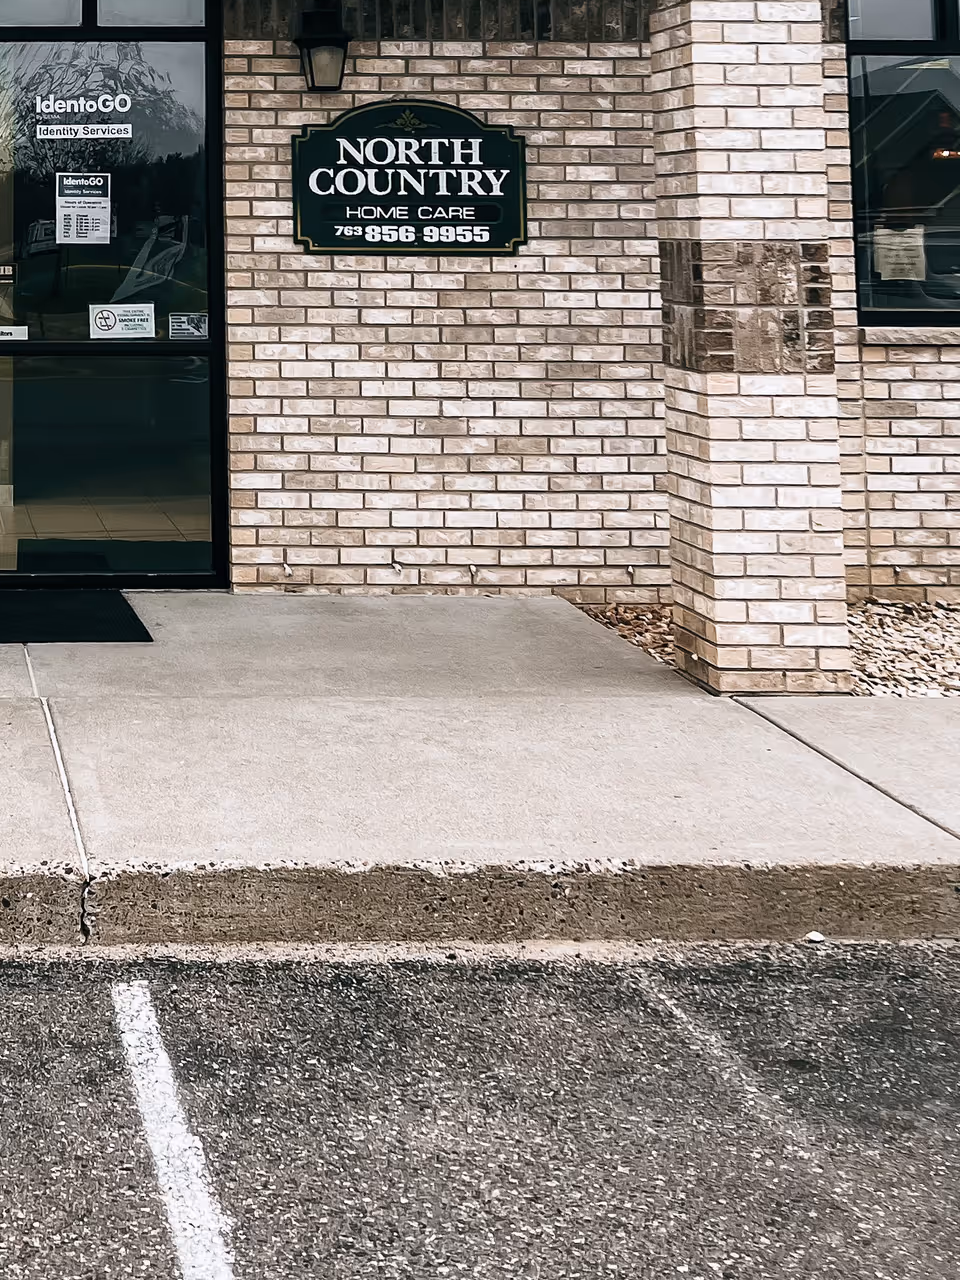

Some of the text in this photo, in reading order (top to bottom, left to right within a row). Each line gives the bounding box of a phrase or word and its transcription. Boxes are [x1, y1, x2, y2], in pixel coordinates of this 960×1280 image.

[36, 94, 132, 113] IdentoGO
[39, 125, 129, 138] Identity Services
[335, 137, 483, 165] NORTH
[63, 176, 103, 186] IdentoGO
[308, 168, 510, 196] COUNTRY
[346, 206, 476, 220] HOME CARE
[334, 225, 363, 237] 763
